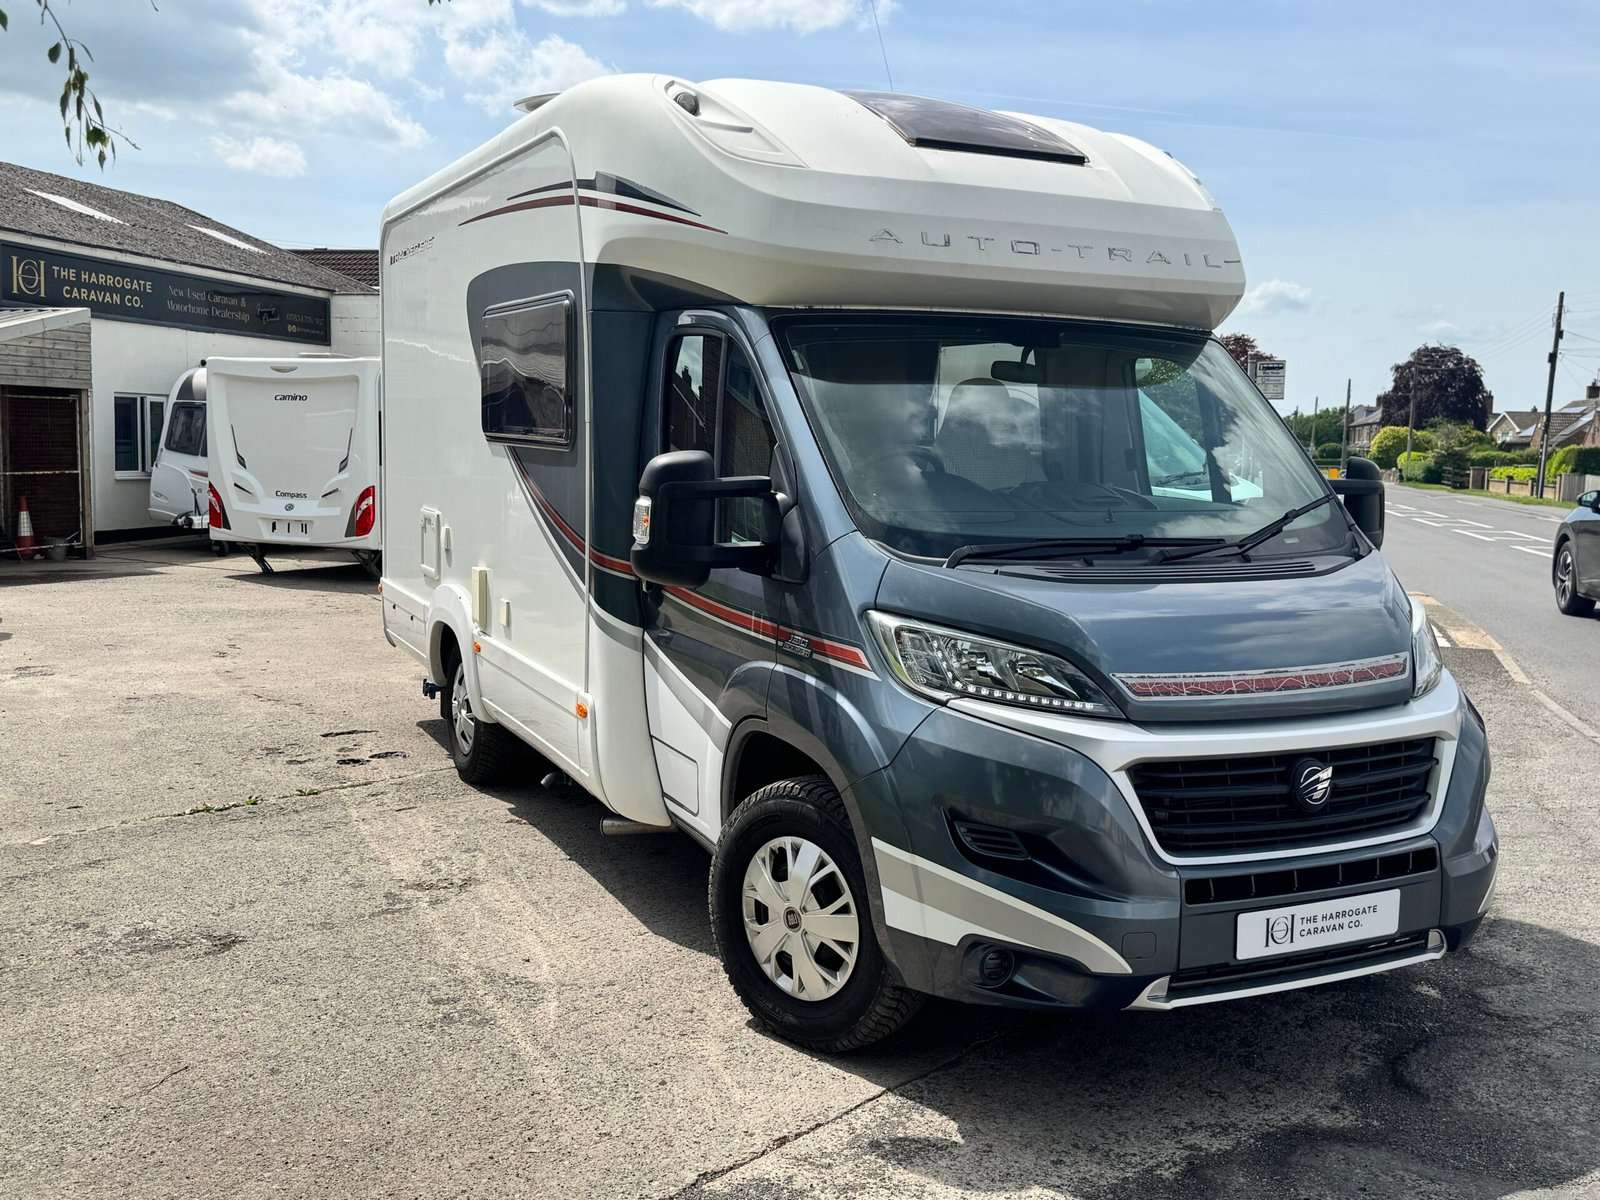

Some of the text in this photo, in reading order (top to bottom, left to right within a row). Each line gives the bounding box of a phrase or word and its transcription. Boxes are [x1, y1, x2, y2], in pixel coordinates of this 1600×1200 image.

[869, 228, 1222, 269] AUTO-TRAIL
[52, 266, 77, 281] THE
[81, 271, 153, 293] HARROGATE
[62, 286, 144, 308] CARAVAN CO.
[168, 285, 246, 307] New Used Caravan &
[167, 299, 250, 324] Motorhome Dealership
[274, 393, 308, 402] camino
[275, 490, 308, 499] Compass
[1300, 905, 1378, 925] THE HARROGATE
[1299, 919, 1364, 937] CARAVAN CO.
